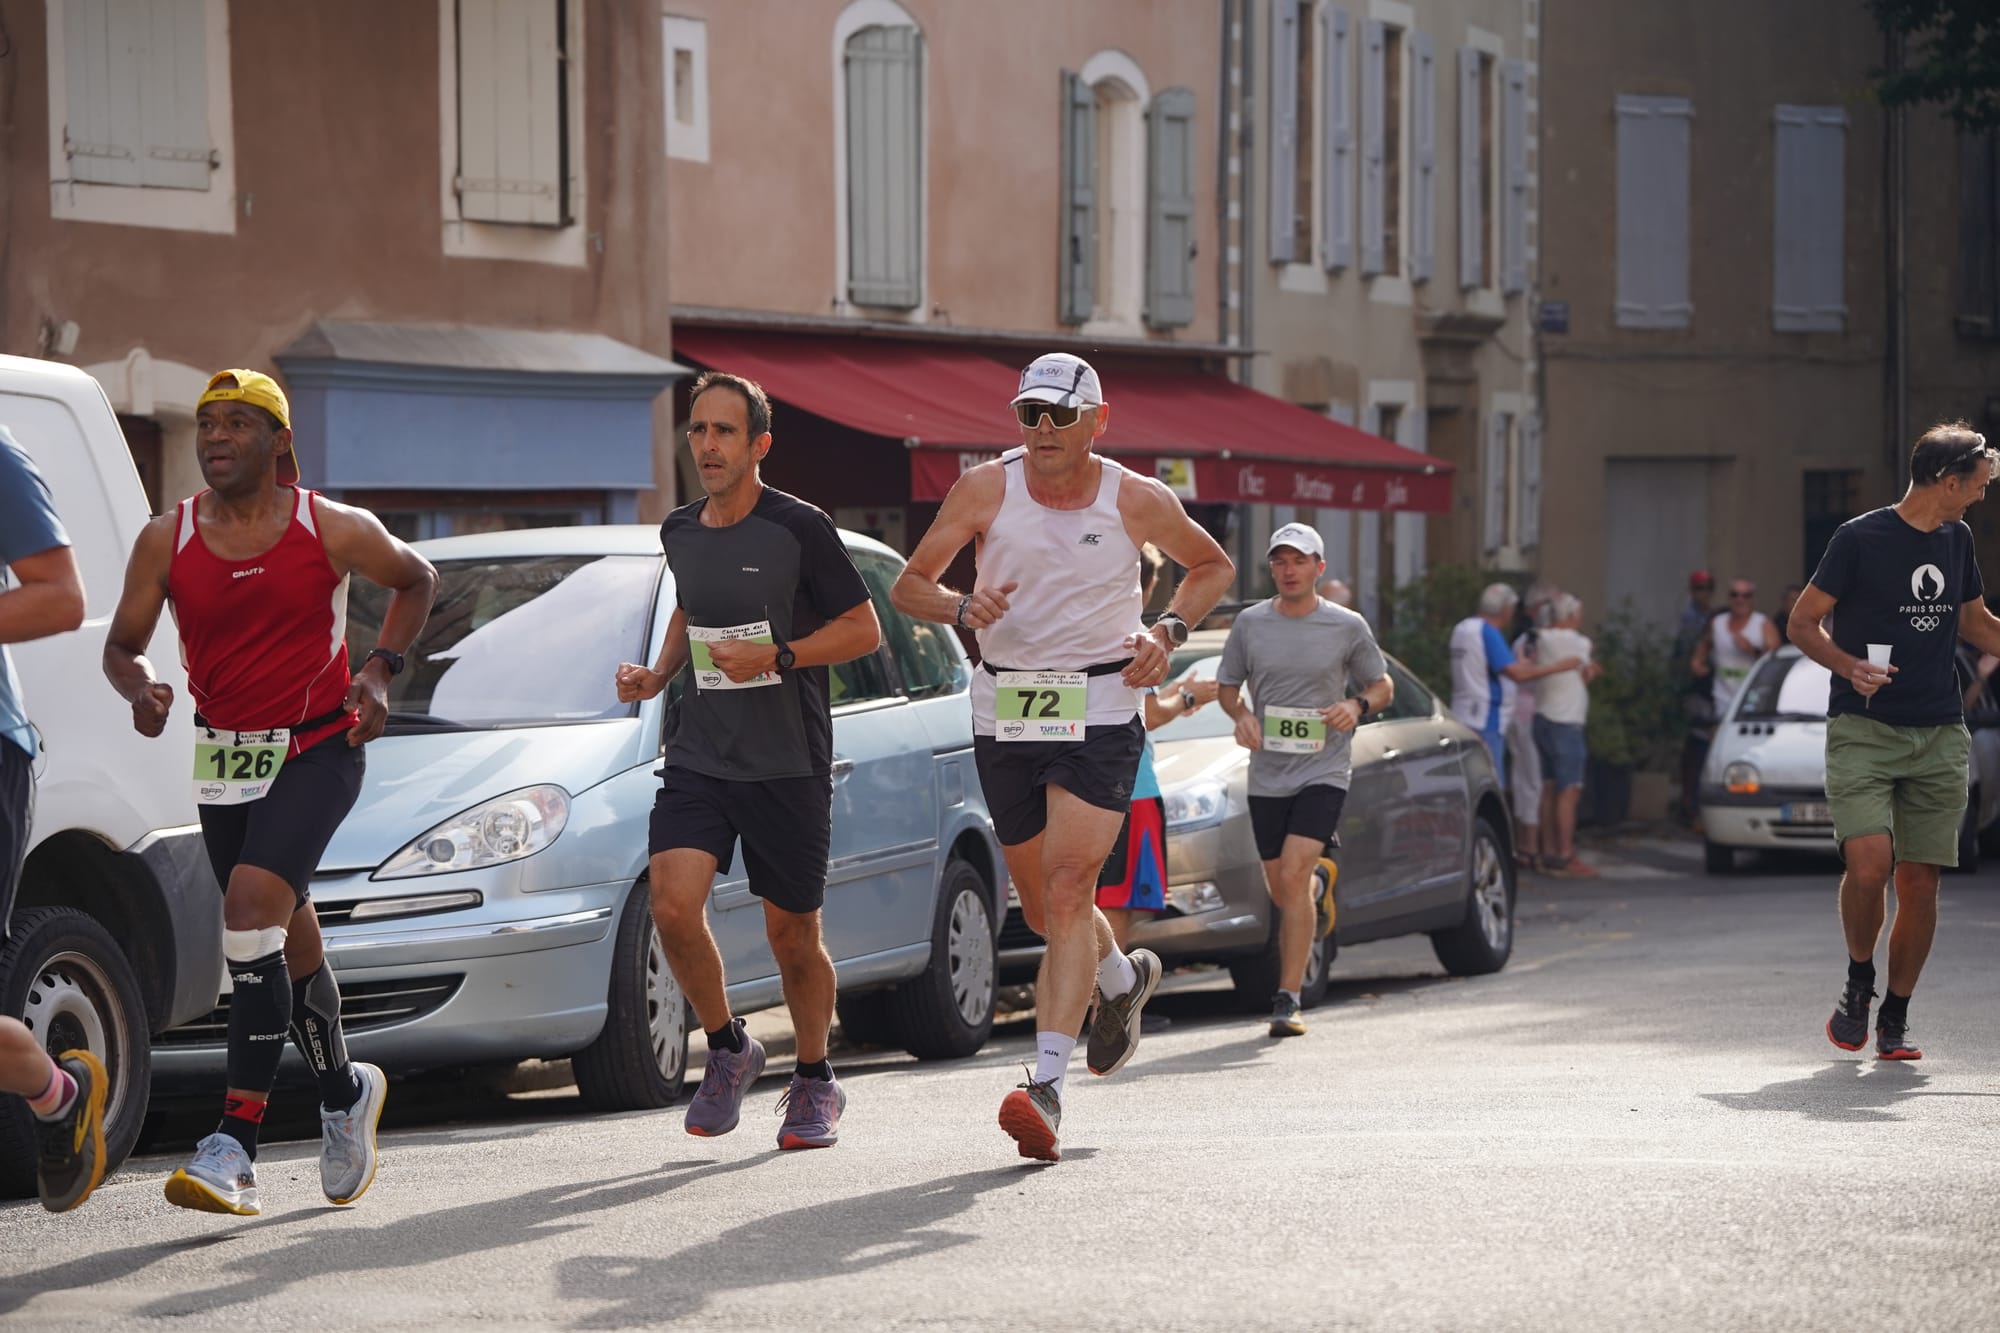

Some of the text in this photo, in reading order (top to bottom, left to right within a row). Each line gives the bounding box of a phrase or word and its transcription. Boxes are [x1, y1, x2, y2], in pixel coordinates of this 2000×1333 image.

[232, 567, 258, 578] CRAFT
[1899, 604, 1953, 613] PARIS 2024
[1017, 690, 1060, 717] 72
[1280, 720, 1309, 738] 86
[210, 748, 275, 779] 126
